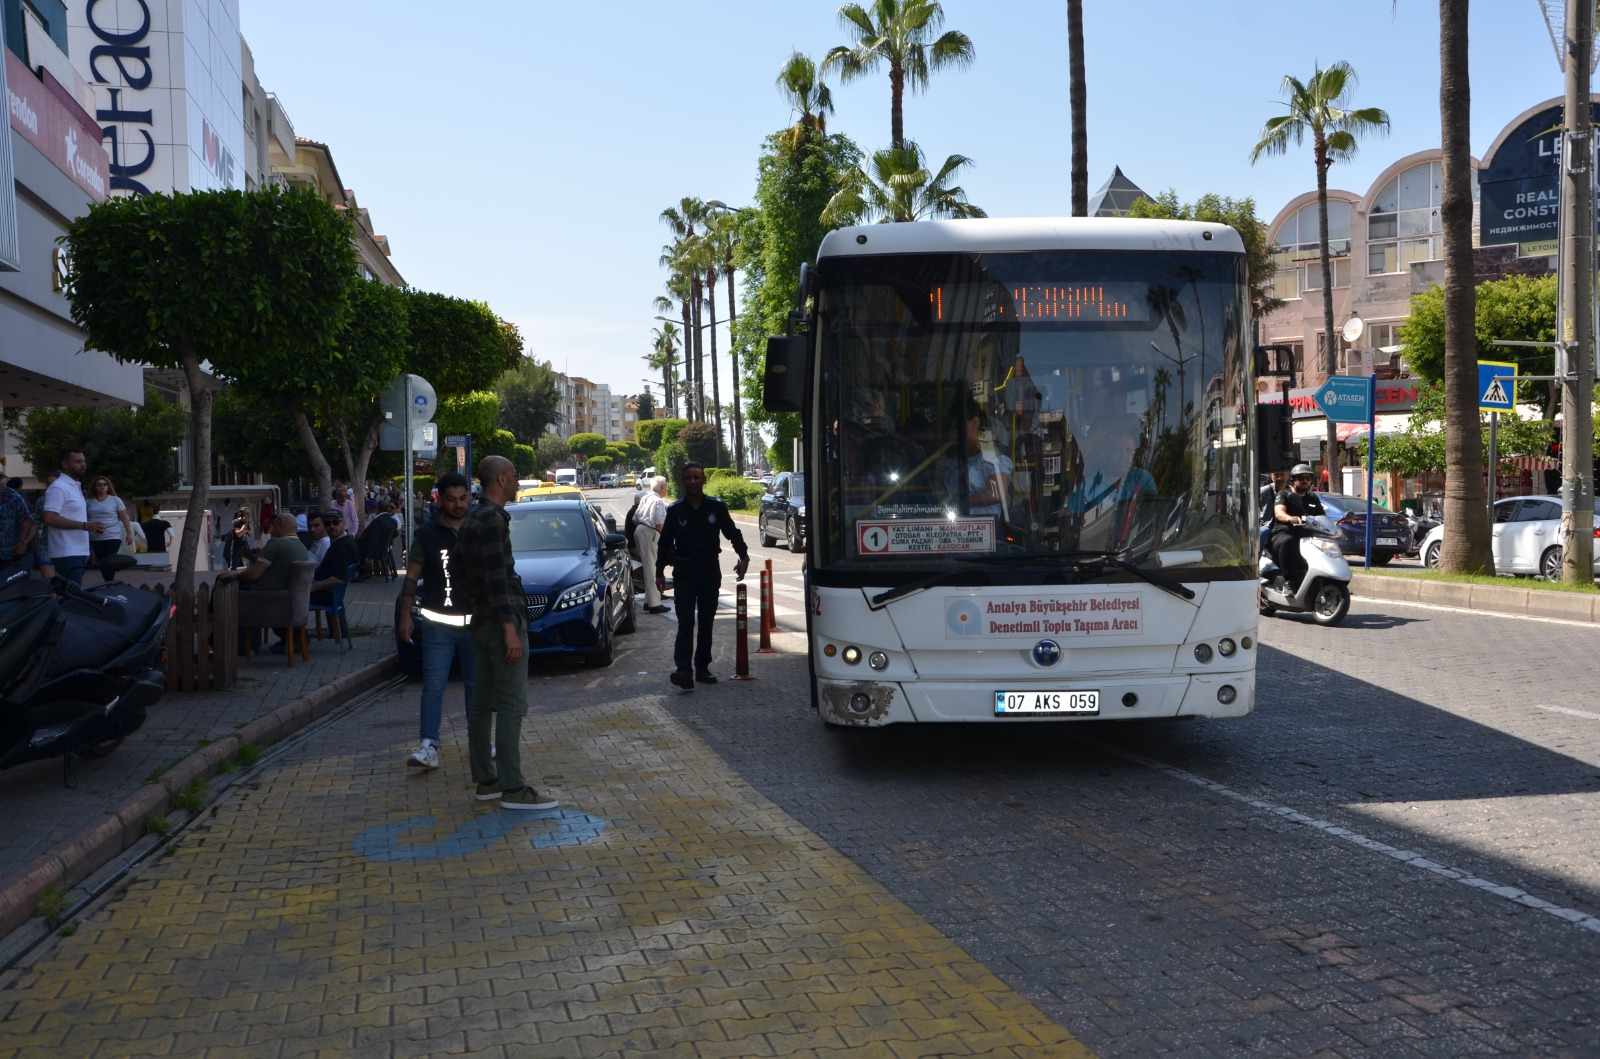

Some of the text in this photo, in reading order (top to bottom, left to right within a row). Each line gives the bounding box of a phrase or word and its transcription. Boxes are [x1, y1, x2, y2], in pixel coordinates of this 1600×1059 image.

[1516, 189, 1559, 204] REAL
[870, 531, 879, 547] 1
[986, 598, 1139, 615] Antalya Büyükşehir Belediyesi
[990, 617, 1138, 634] Denetimli Toplu Taşıma Aracı
[1008, 694, 1096, 709] 07 AKS 059
